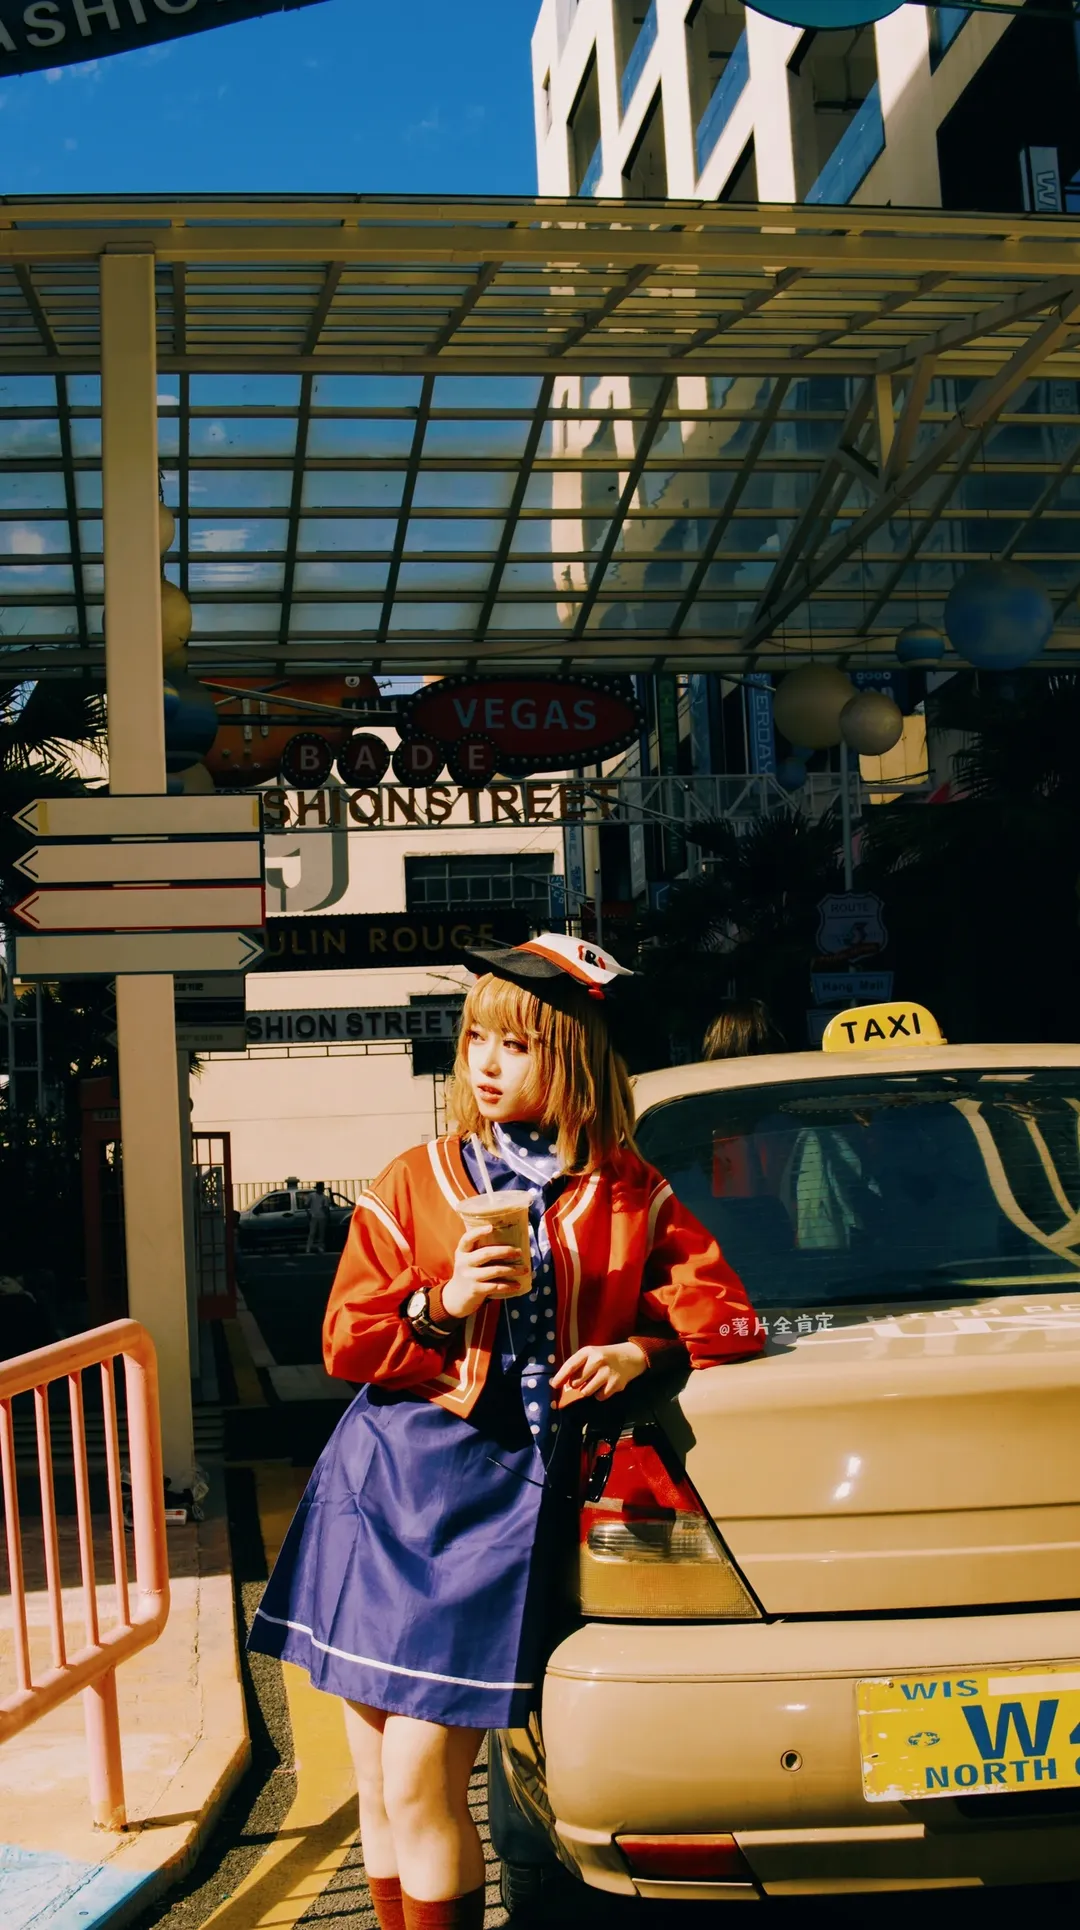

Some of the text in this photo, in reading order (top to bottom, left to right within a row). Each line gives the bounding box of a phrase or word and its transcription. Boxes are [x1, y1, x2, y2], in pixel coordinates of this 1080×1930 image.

[452, 698, 597, 730] VEGAS
[831, 901, 869, 913] ROUTE
[368, 924, 494, 953] ROUGE
[246, 1014, 337, 1041] SHION
[840, 1012, 921, 1044] TAXI
[900, 1679, 979, 1700] WIS
[925, 1758, 1057, 1789] NORTH
